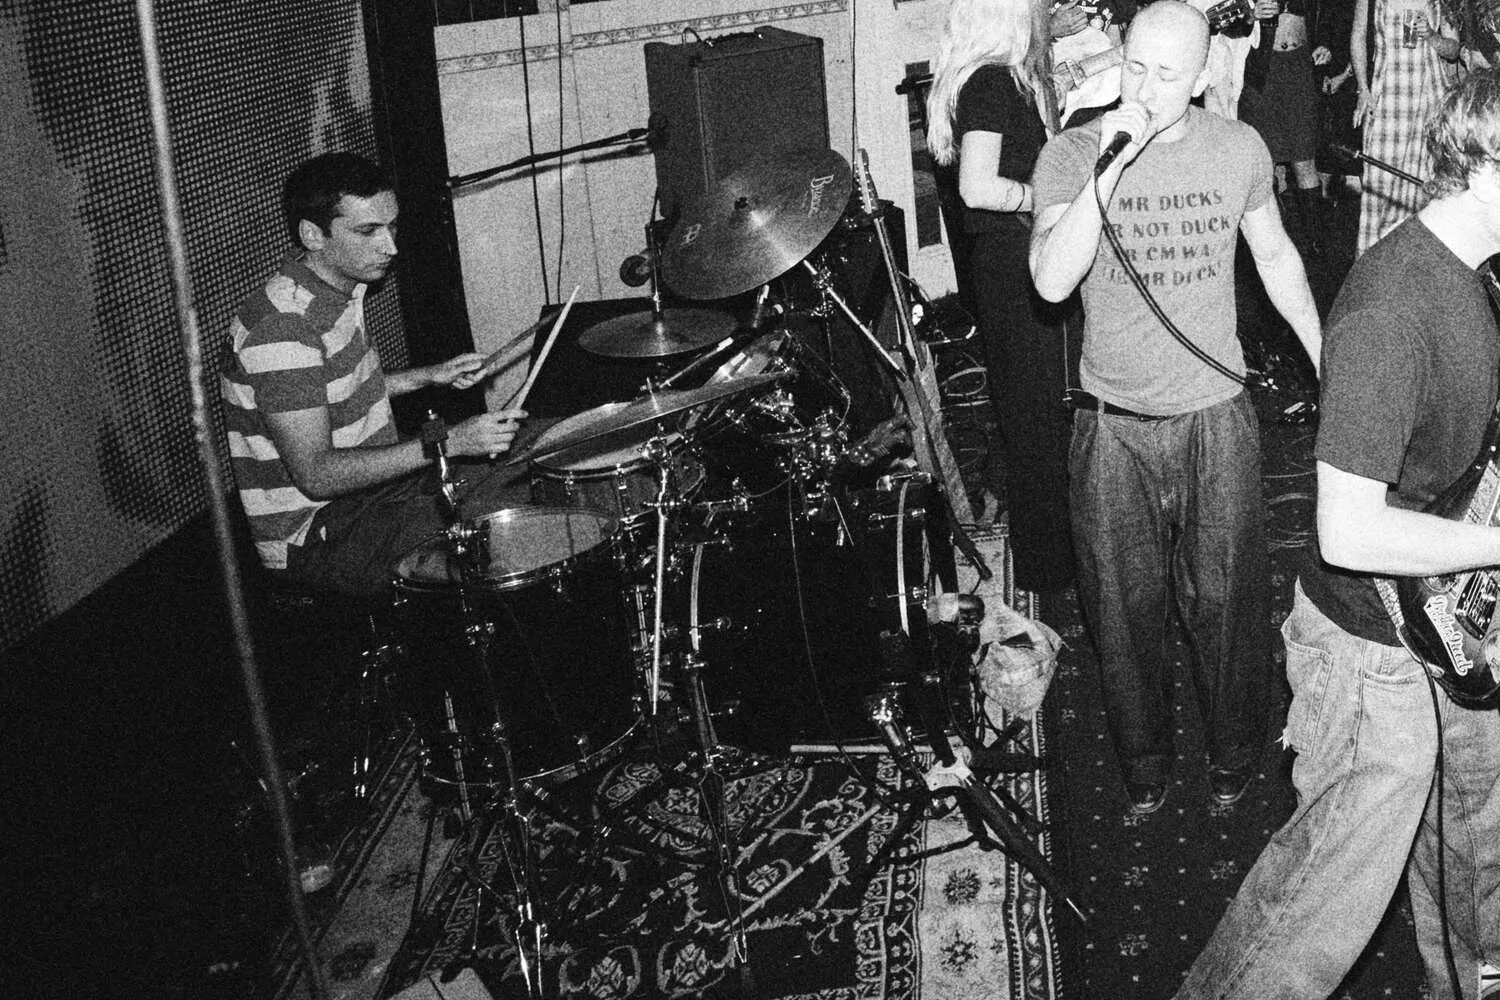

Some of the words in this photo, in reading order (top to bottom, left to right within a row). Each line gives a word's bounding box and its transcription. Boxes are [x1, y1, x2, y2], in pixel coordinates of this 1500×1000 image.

[1118, 196, 1149, 212] MR
[1159, 189, 1222, 211] DUCKS
[1133, 222, 1169, 238] NOT
[1180, 214, 1240, 239] DUCK
